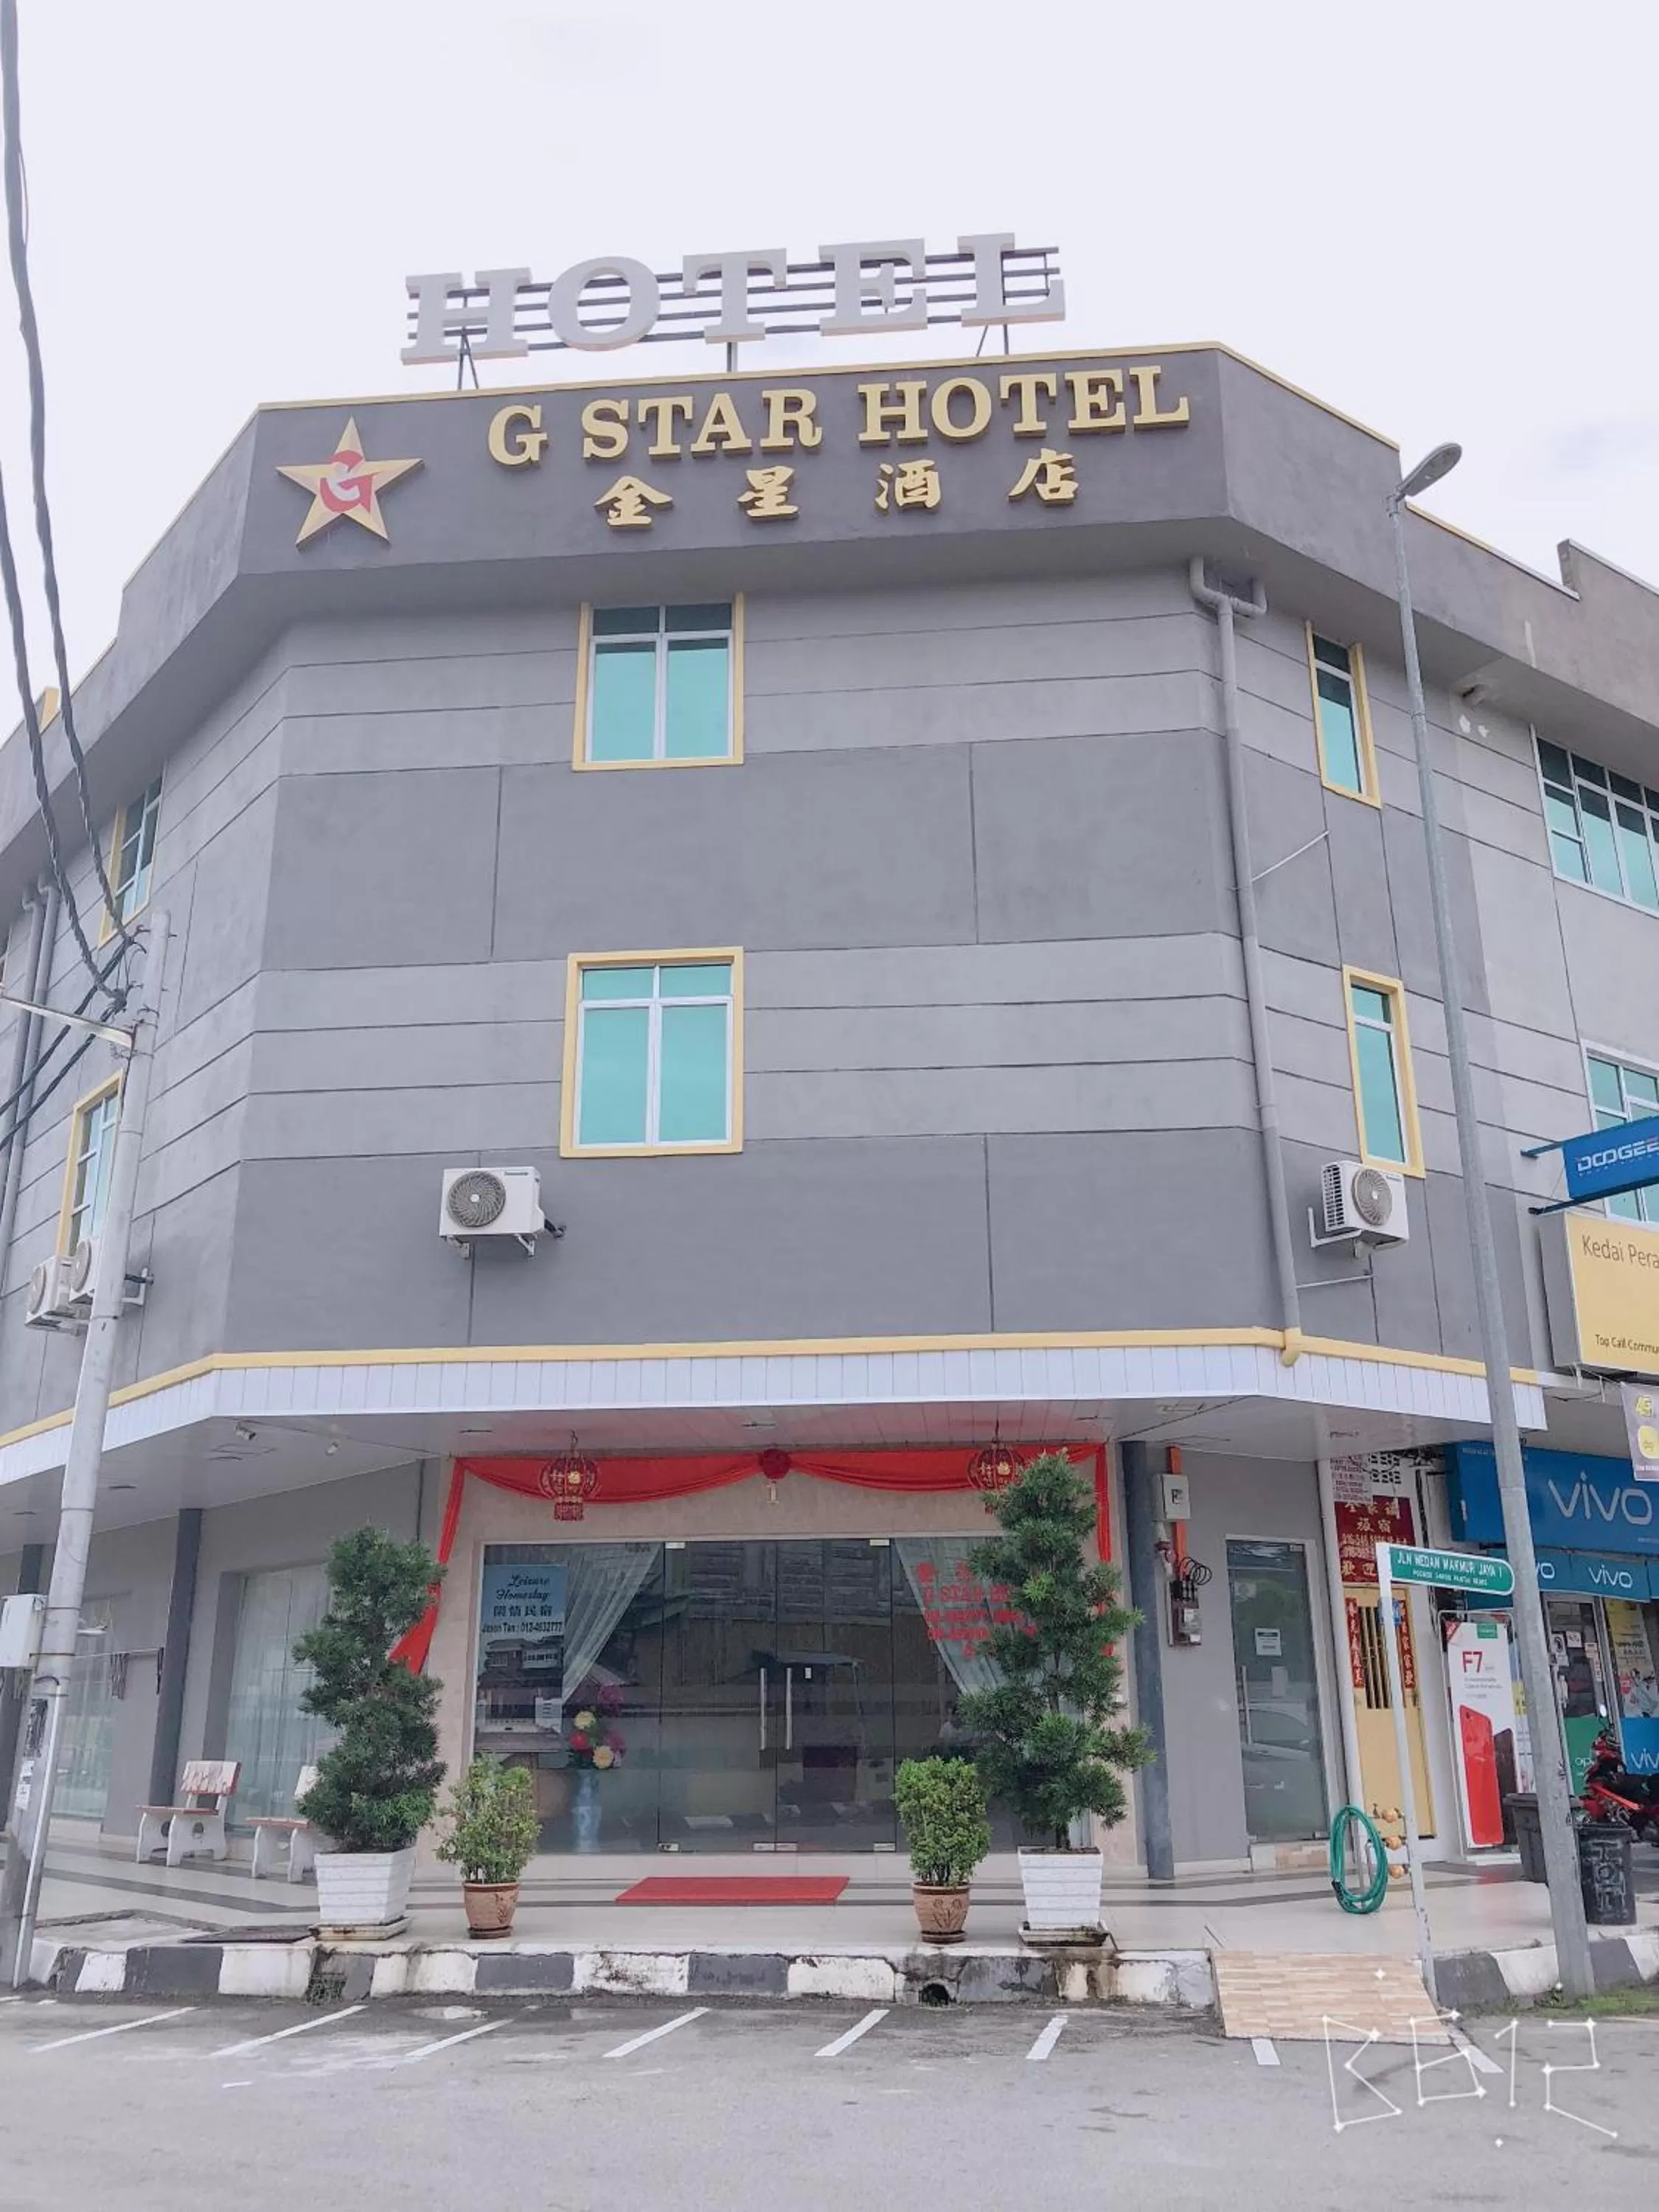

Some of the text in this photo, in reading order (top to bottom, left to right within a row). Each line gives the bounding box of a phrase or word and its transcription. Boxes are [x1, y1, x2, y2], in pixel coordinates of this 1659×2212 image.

[401, 232, 1065, 364] HOTEL
[488, 366, 1189, 467] G STAR HOTEL
[594, 448, 1079, 529] 金星酒店
[1582, 1234, 1659, 1269] Kedai Pera
[1595, 1334, 1610, 1349] Top
[1611, 1336, 1627, 1349] Call
[1548, 1471, 1652, 1525] vivo
[1397, 1551, 1412, 1565] JLN
[1414, 1554, 1440, 1569] MEDAN
[1478, 1562, 1496, 1576] JAYA
[1587, 1564, 1633, 1588] vivo
[1462, 1651, 1483, 1673] F7
[1630, 1747, 1659, 1770] viv
